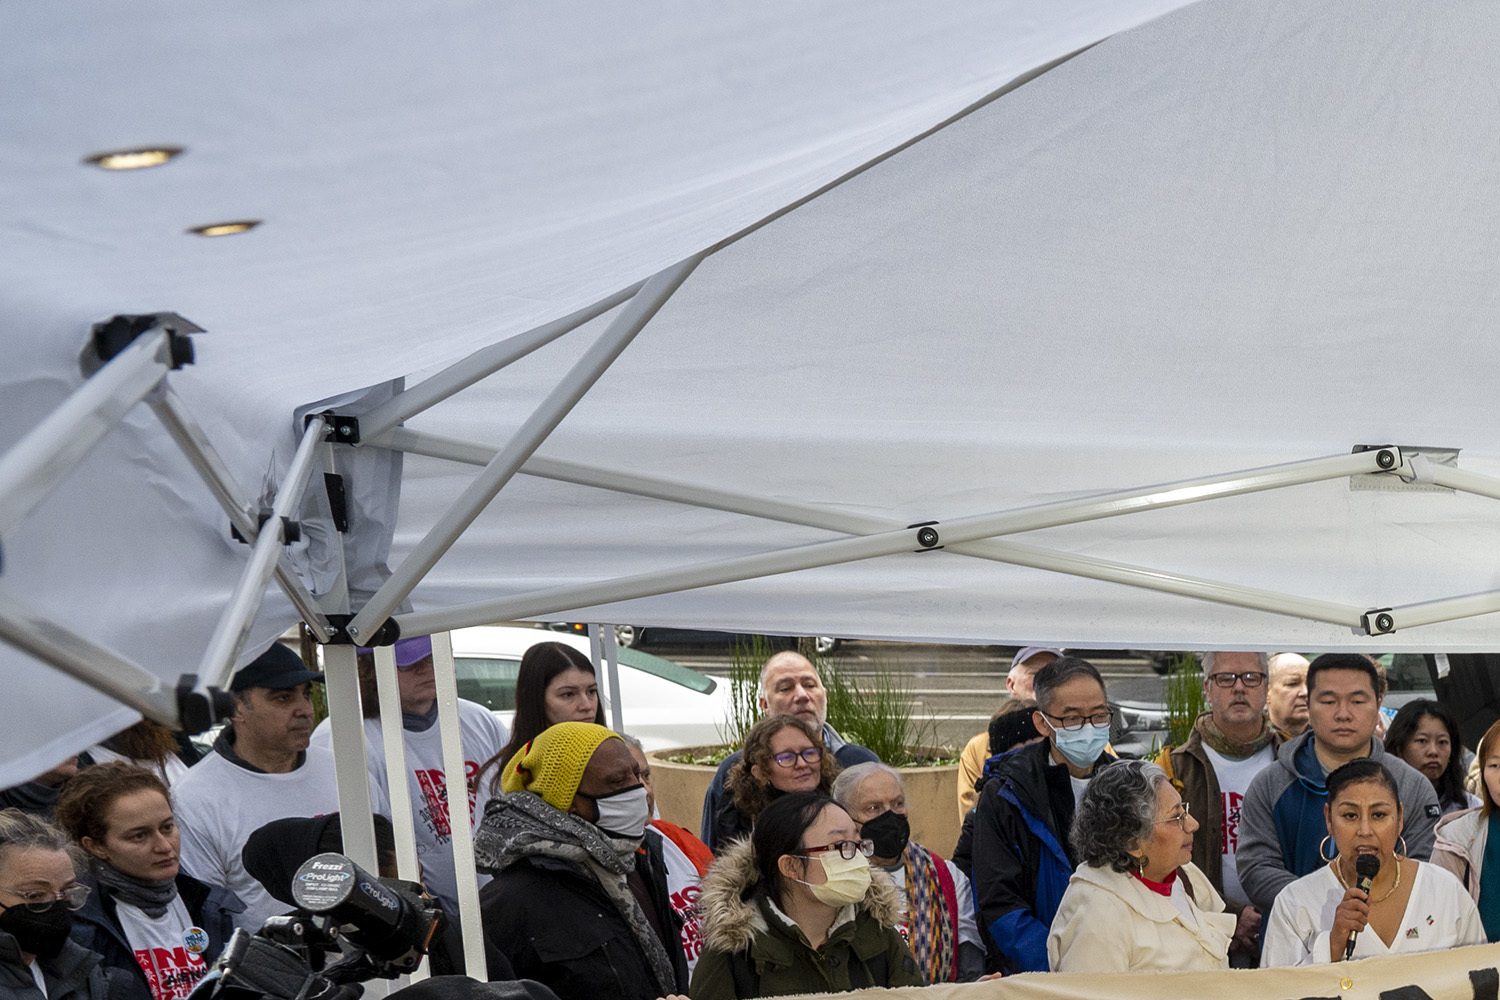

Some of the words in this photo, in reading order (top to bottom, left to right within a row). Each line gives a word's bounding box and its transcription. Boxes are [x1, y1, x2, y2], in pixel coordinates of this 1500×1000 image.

[311, 861, 344, 871] Frezzi
[306, 872, 346, 882] ProLight
[364, 882, 396, 911] ProLight
